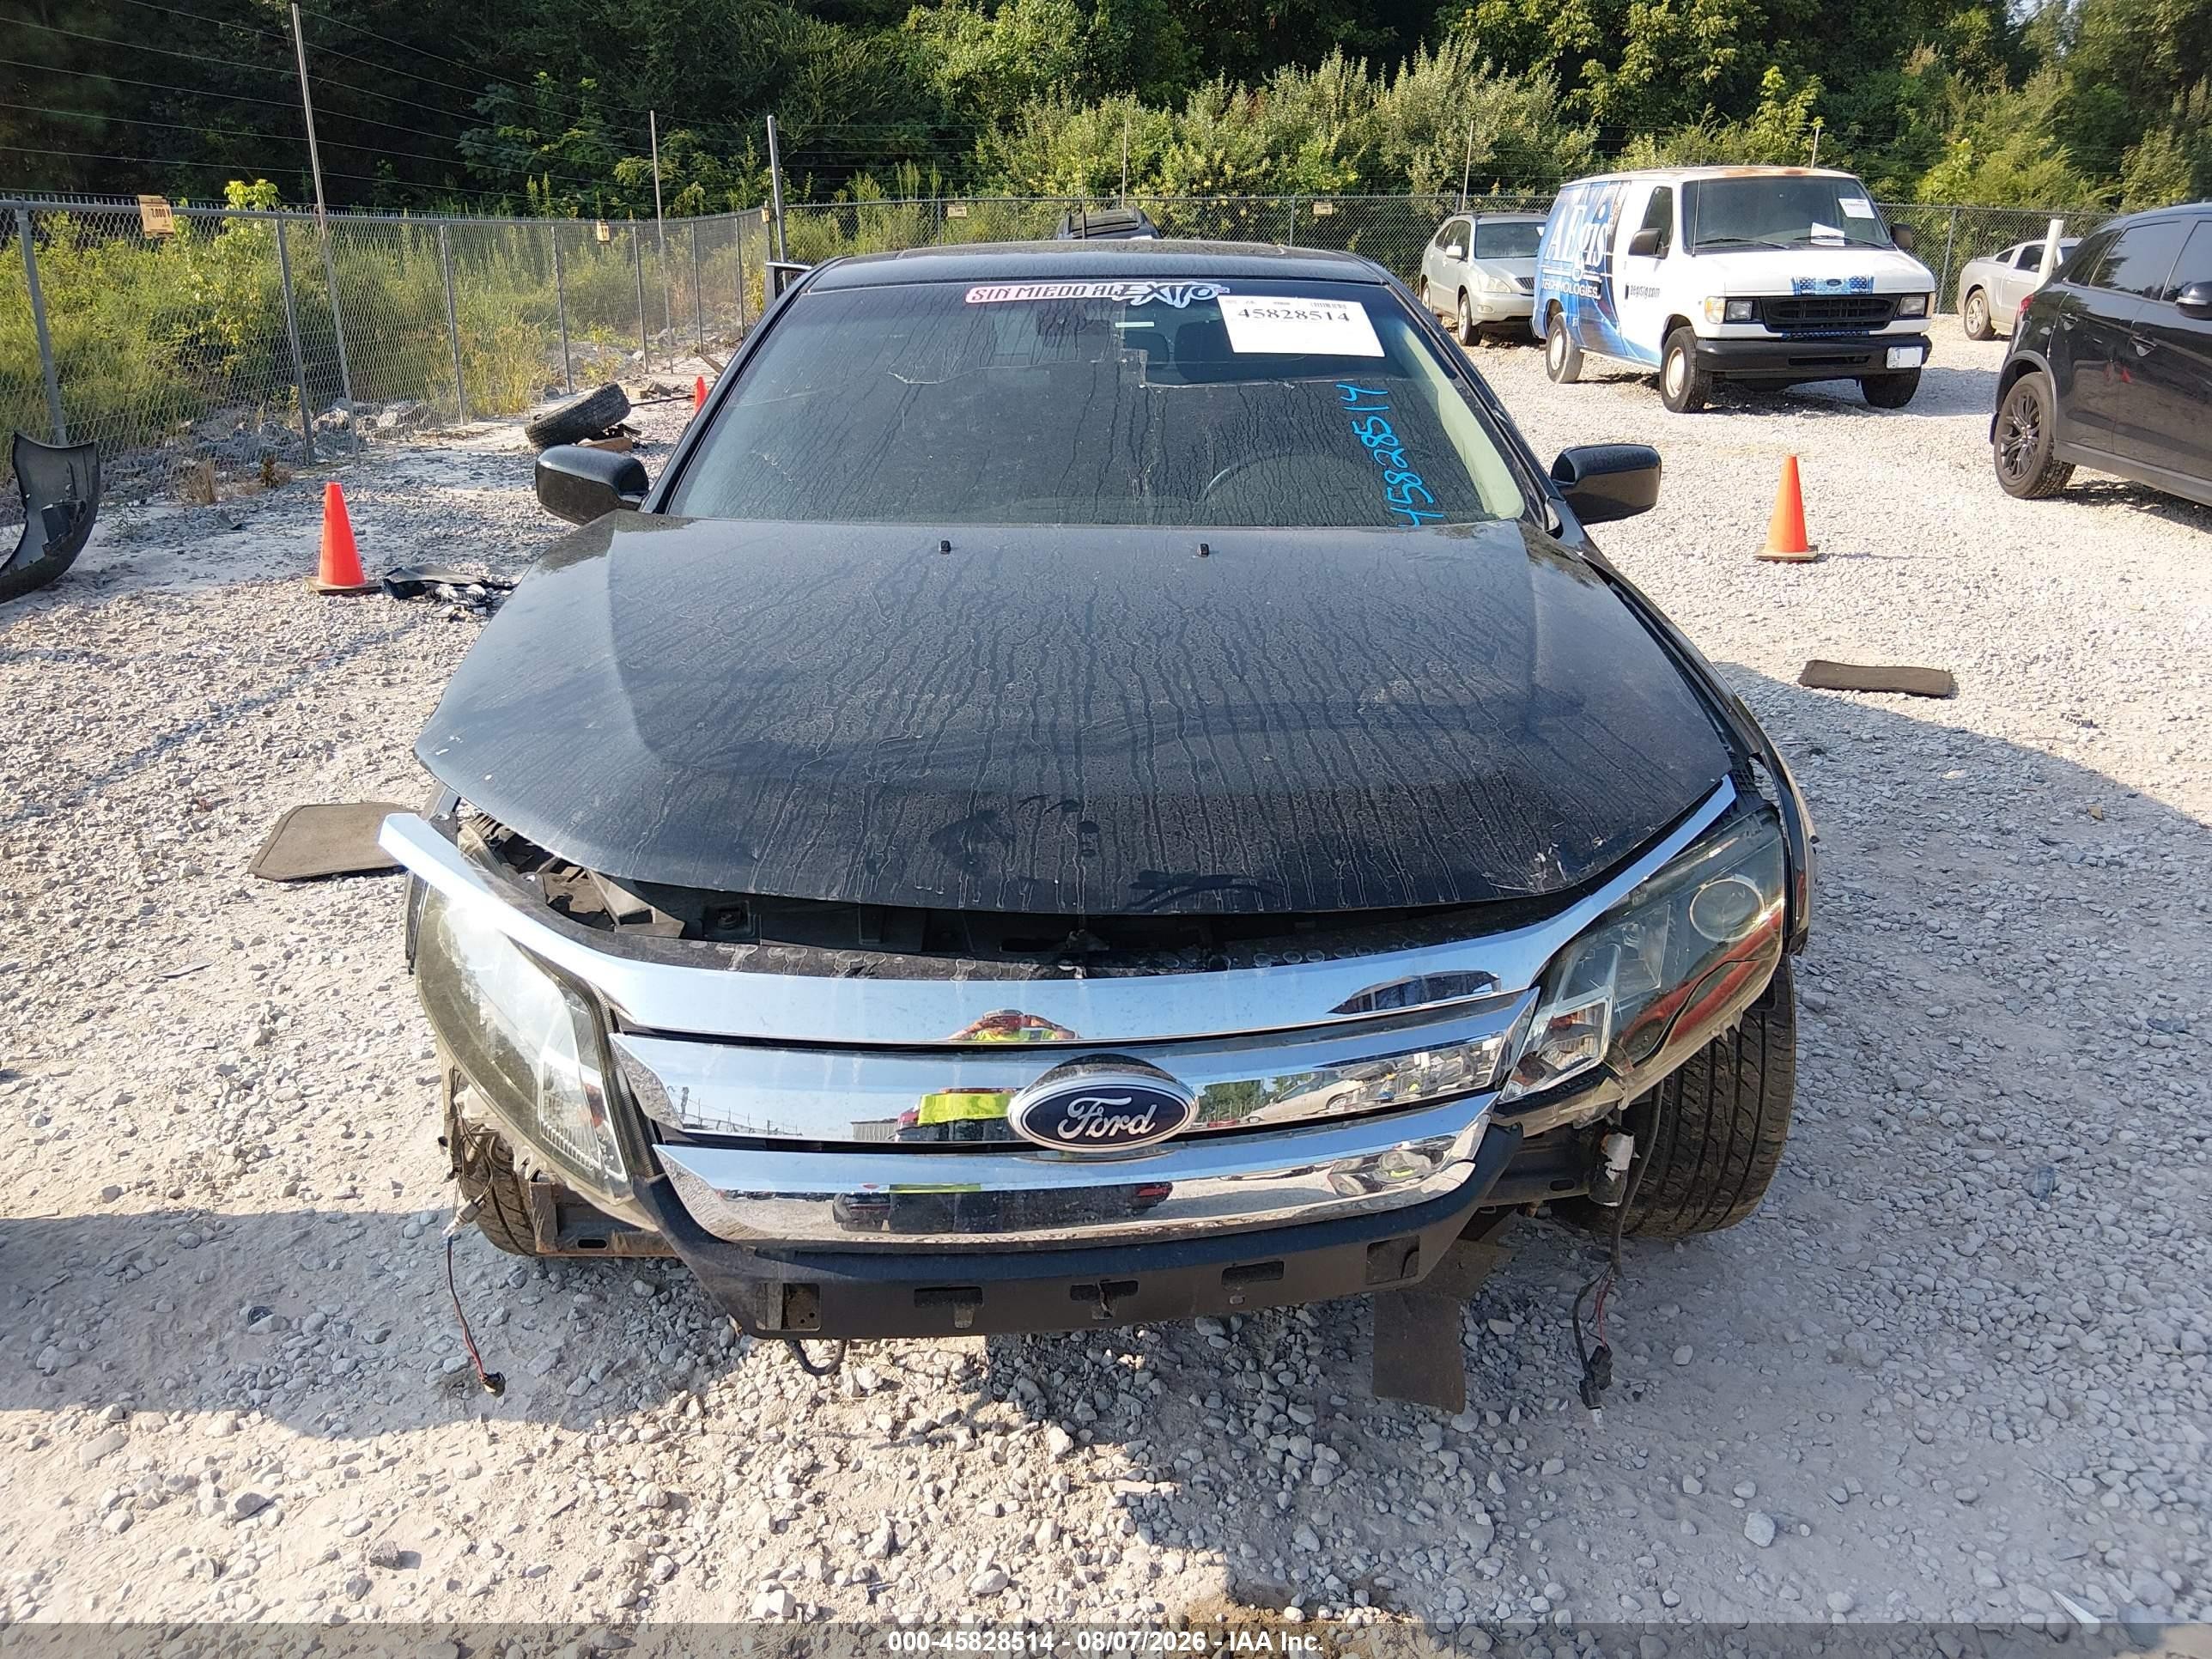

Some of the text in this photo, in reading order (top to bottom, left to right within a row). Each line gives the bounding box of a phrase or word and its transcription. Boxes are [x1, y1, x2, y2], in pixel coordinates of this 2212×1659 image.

[971, 288, 1011, 301] SIN
[1014, 284, 1088, 298] MIEDO
[1237, 307, 1351, 322] 45828514
[1336, 384, 1444, 528] 45828514
[1057, 1096, 1158, 1140] Ford
